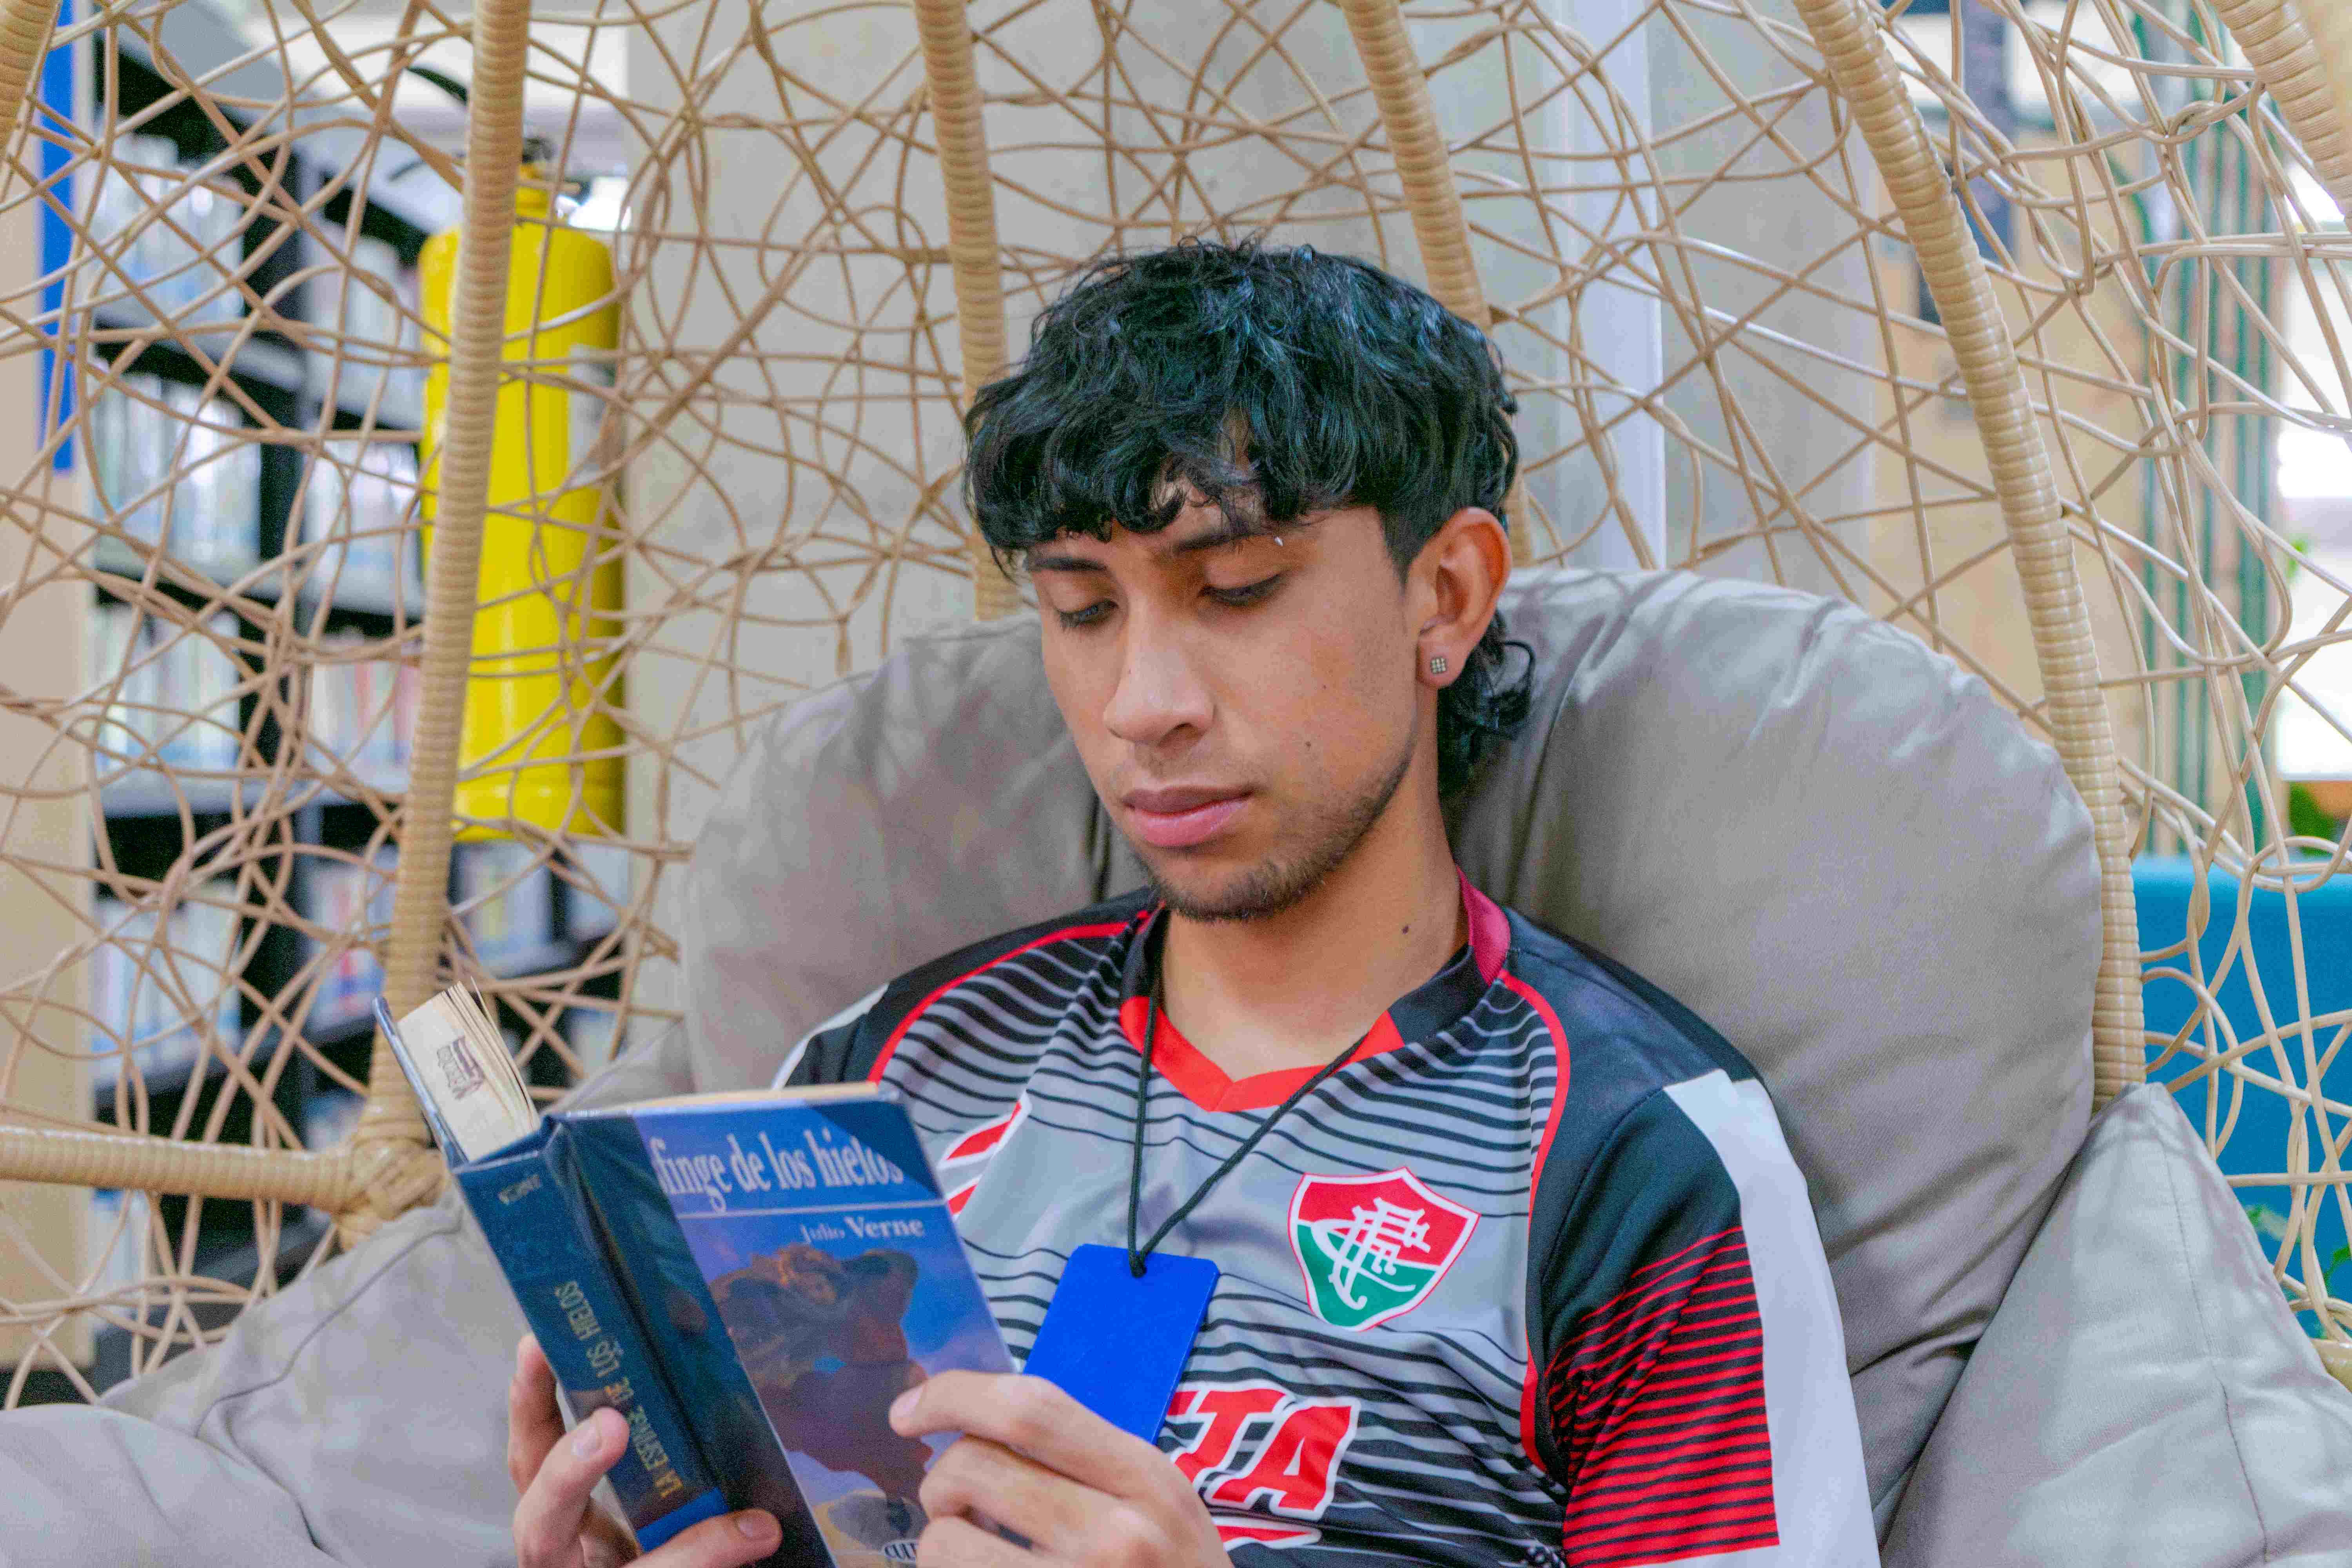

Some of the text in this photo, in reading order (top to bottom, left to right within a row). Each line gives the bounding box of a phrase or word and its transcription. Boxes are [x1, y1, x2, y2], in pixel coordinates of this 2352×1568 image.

[726, 1133, 771, 1192] de
[759, 1131, 816, 1190] los
[800, 1216, 924, 1245] Julio Verne
[554, 1280, 602, 1341] HIELOS
[586, 1339, 622, 1378] LOS
[605, 1376, 634, 1405] DE
[654, 1468, 683, 1498] LA
